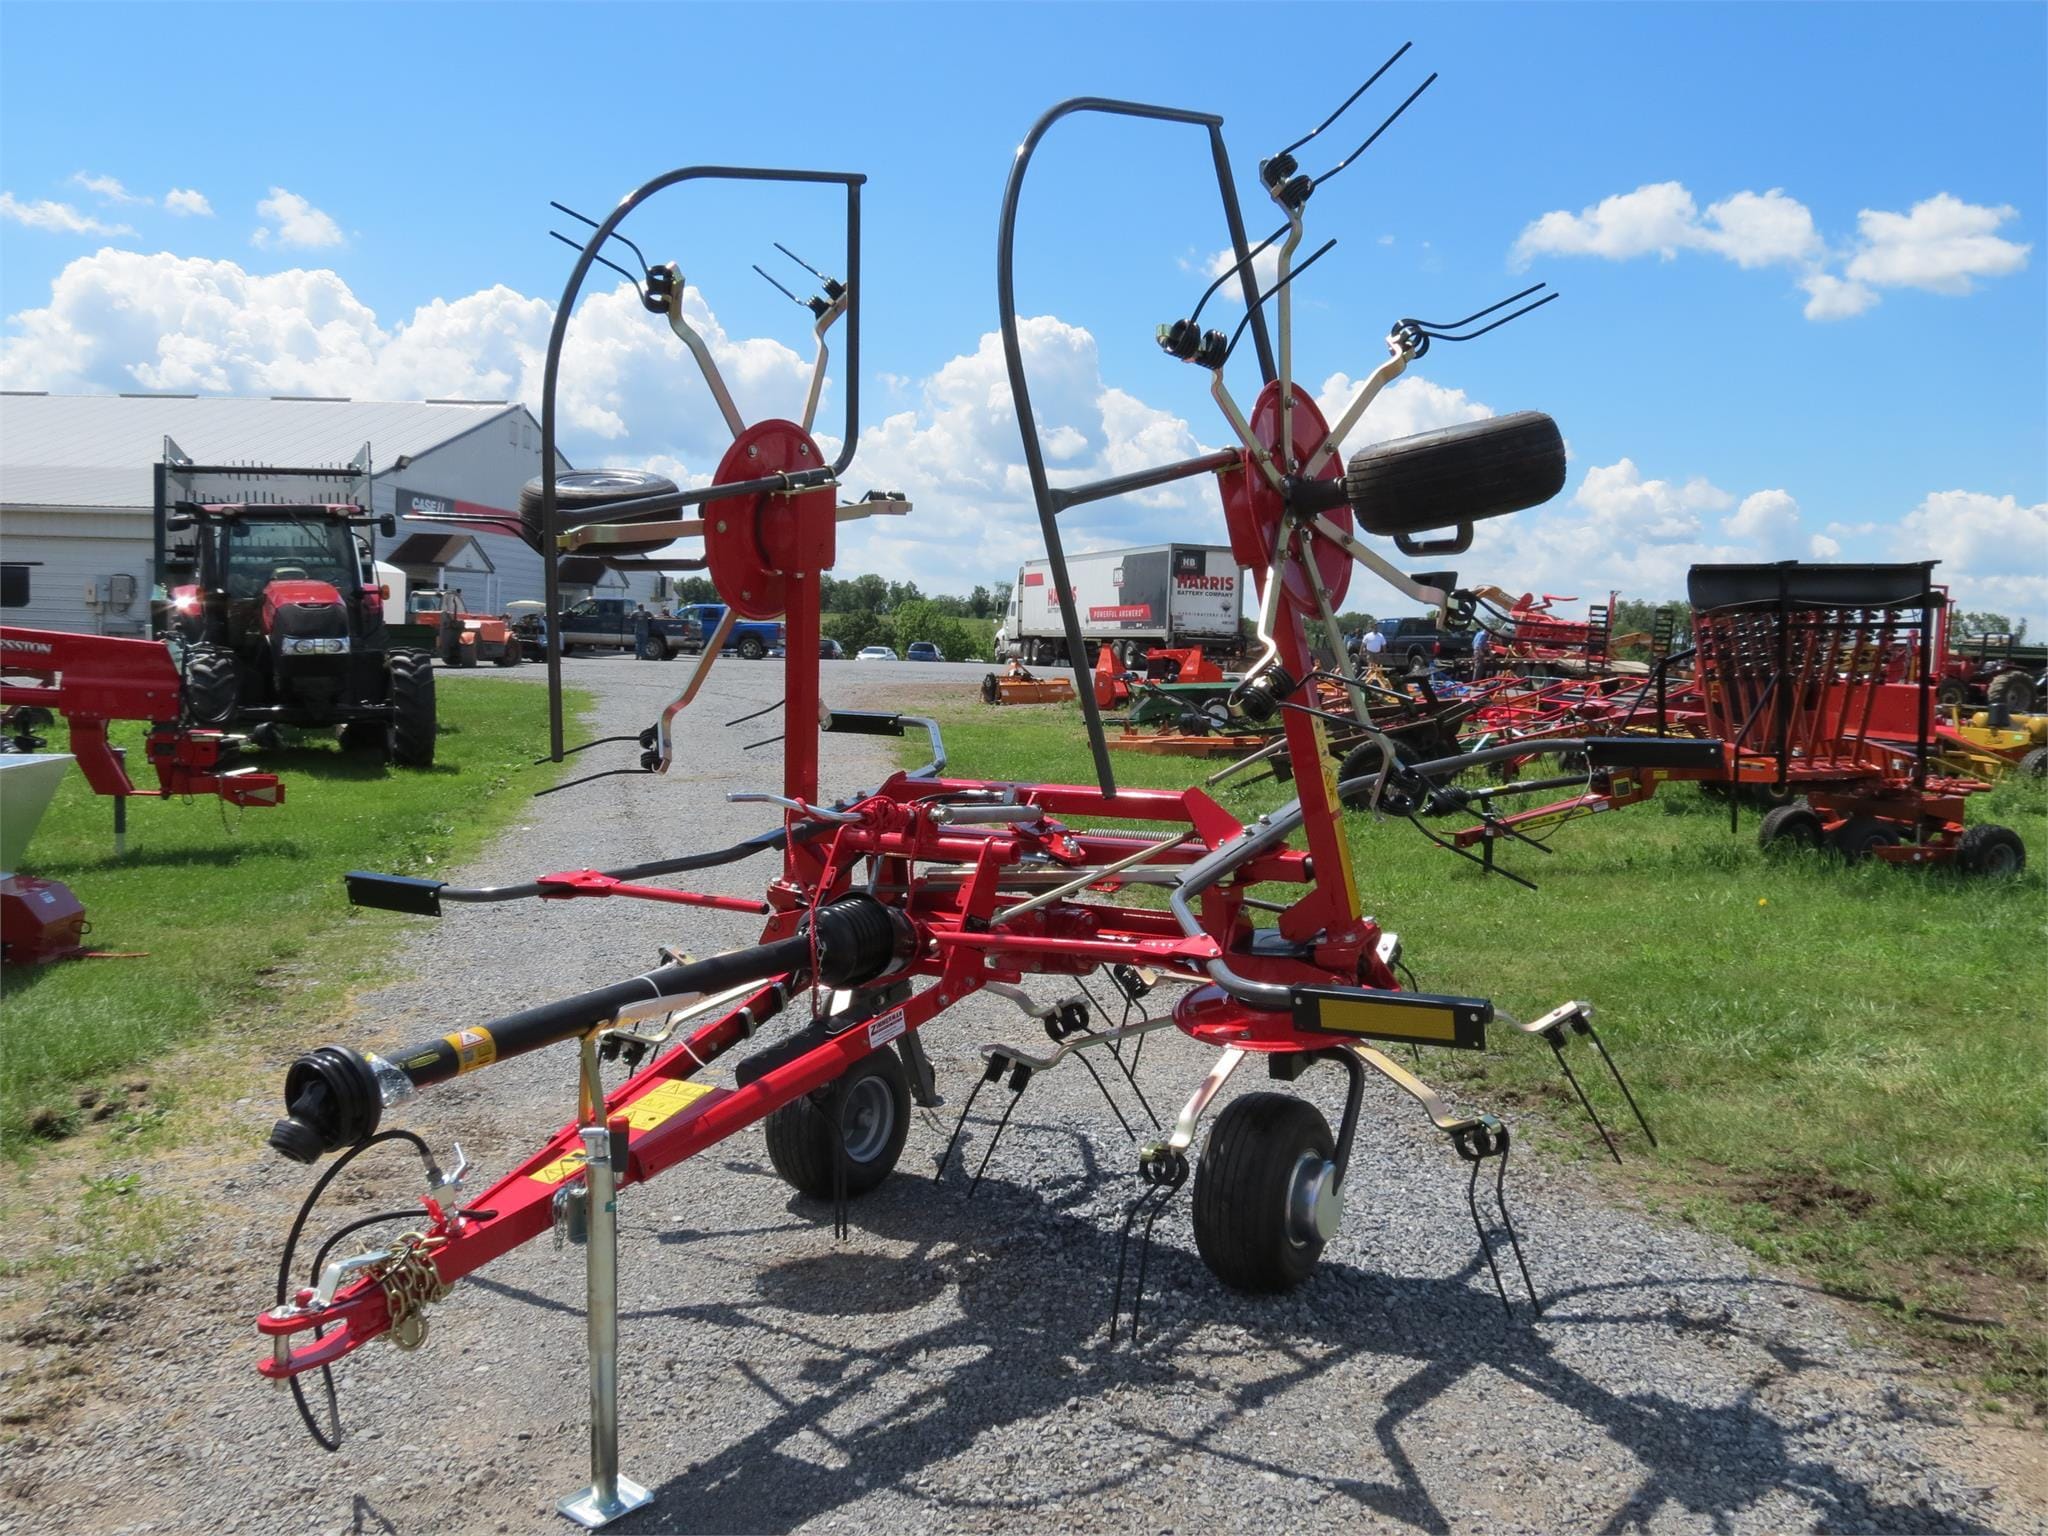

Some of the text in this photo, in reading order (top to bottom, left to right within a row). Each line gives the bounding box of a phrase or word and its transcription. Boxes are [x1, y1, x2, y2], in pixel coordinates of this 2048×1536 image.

[412, 498, 436, 512] CASE
[1177, 575, 1234, 591] HARRIS
[1093, 610, 1118, 618] POWERFUL
